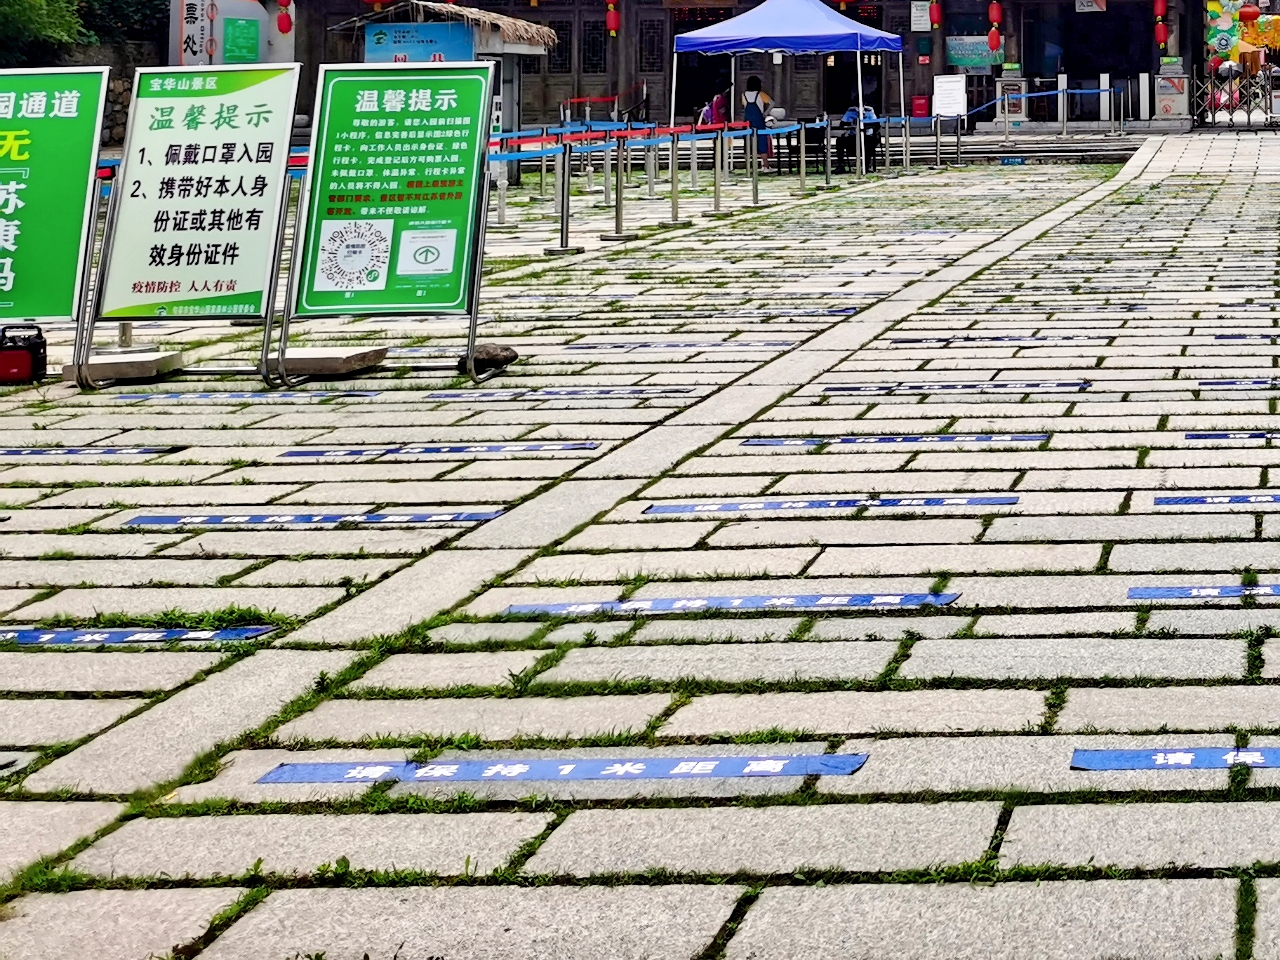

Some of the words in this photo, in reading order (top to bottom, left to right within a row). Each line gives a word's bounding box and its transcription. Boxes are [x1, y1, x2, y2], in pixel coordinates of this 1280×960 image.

[149, 77, 218, 91] 宝华山景区
[355, 89, 458, 112] 温馨提示
[148, 103, 273, 131] 温馨提示
[138, 142, 274, 166] 1、佩戴口罩入园
[130, 175, 268, 199] 2、携带好本人身
[153, 208, 264, 232] 份证或其他有
[149, 242, 240, 267] 效身份证件
[131, 281, 181, 294] 疫情防控
[187, 279, 238, 292] 人人有责
[344, 758, 790, 779] 请保持1米距离
